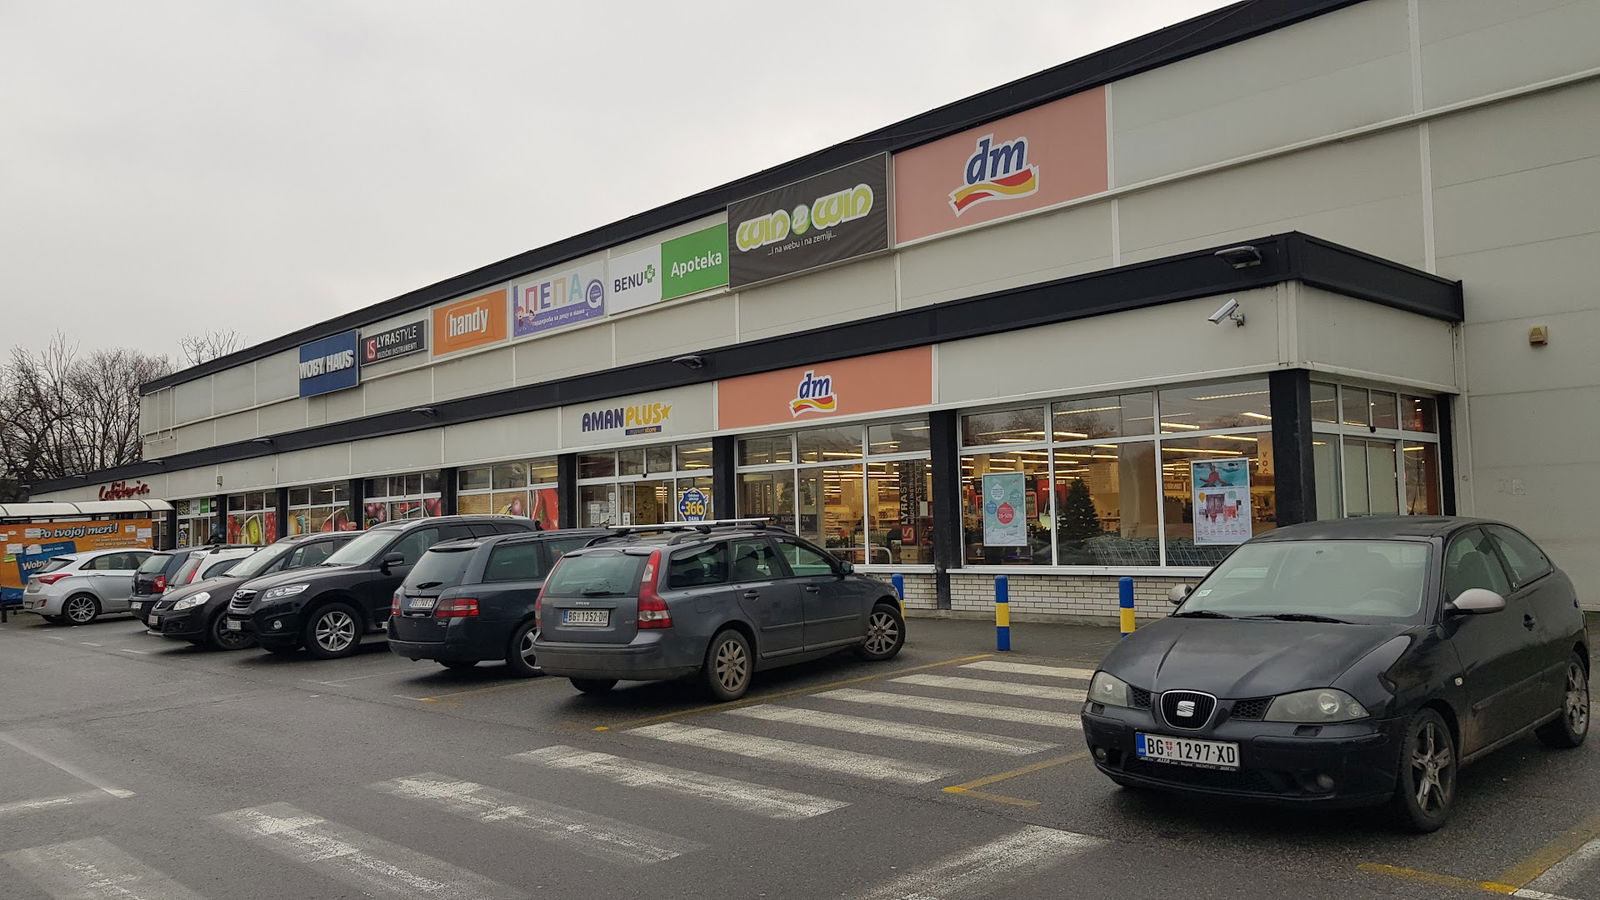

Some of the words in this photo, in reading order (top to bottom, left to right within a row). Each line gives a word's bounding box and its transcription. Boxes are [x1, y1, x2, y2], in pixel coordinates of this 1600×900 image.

[967, 138, 1025, 185] dm
[783, 240, 801, 251] webu
[670, 250, 723, 278] Apoteka
[614, 276, 644, 293] BENU
[449, 307, 488, 337] handy
[376, 326, 417, 348] LYRASTYLE
[299, 356, 326, 379] WOBY
[326, 349, 354, 374] HAUS
[799, 373, 830, 400] dm
[683, 499, 704, 515] 366
[54, 525, 86, 539] tvojoj
[87, 523, 119, 535] meri!
[22, 557, 47, 571] Woby
[1147, 738, 1164, 756] BG
